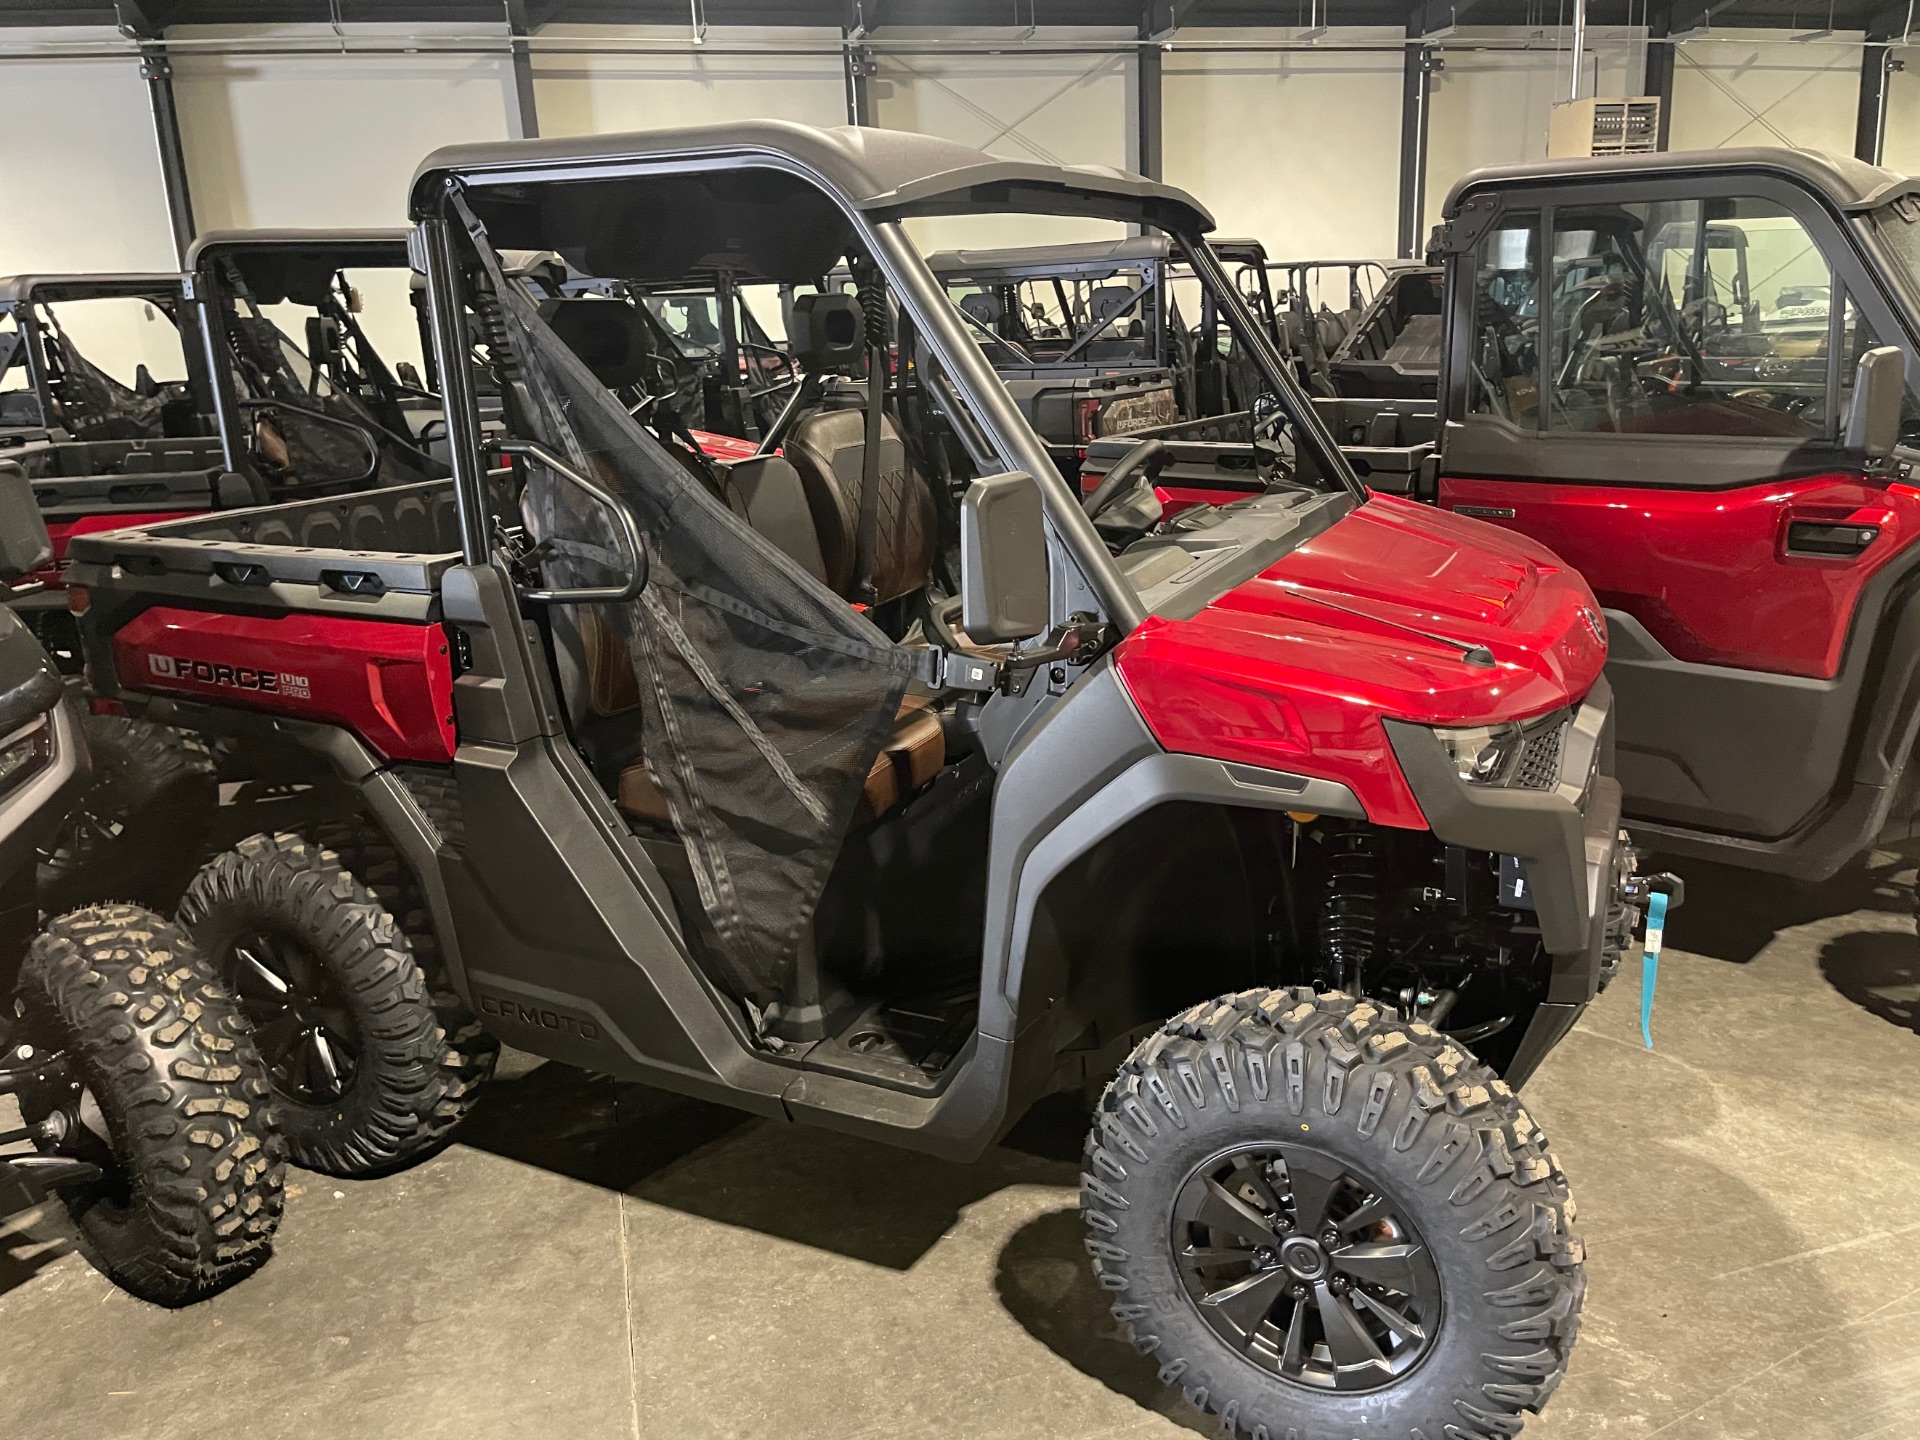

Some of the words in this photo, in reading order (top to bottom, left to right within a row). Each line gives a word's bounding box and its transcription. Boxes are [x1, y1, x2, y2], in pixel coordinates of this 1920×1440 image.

[1116, 417, 1147, 430] UFORCE
[148, 653, 280, 694] UFORCE
[280, 673, 309, 687] U10
[282, 685, 311, 698] PRO
[480, 994, 600, 1041] CFMOTO
